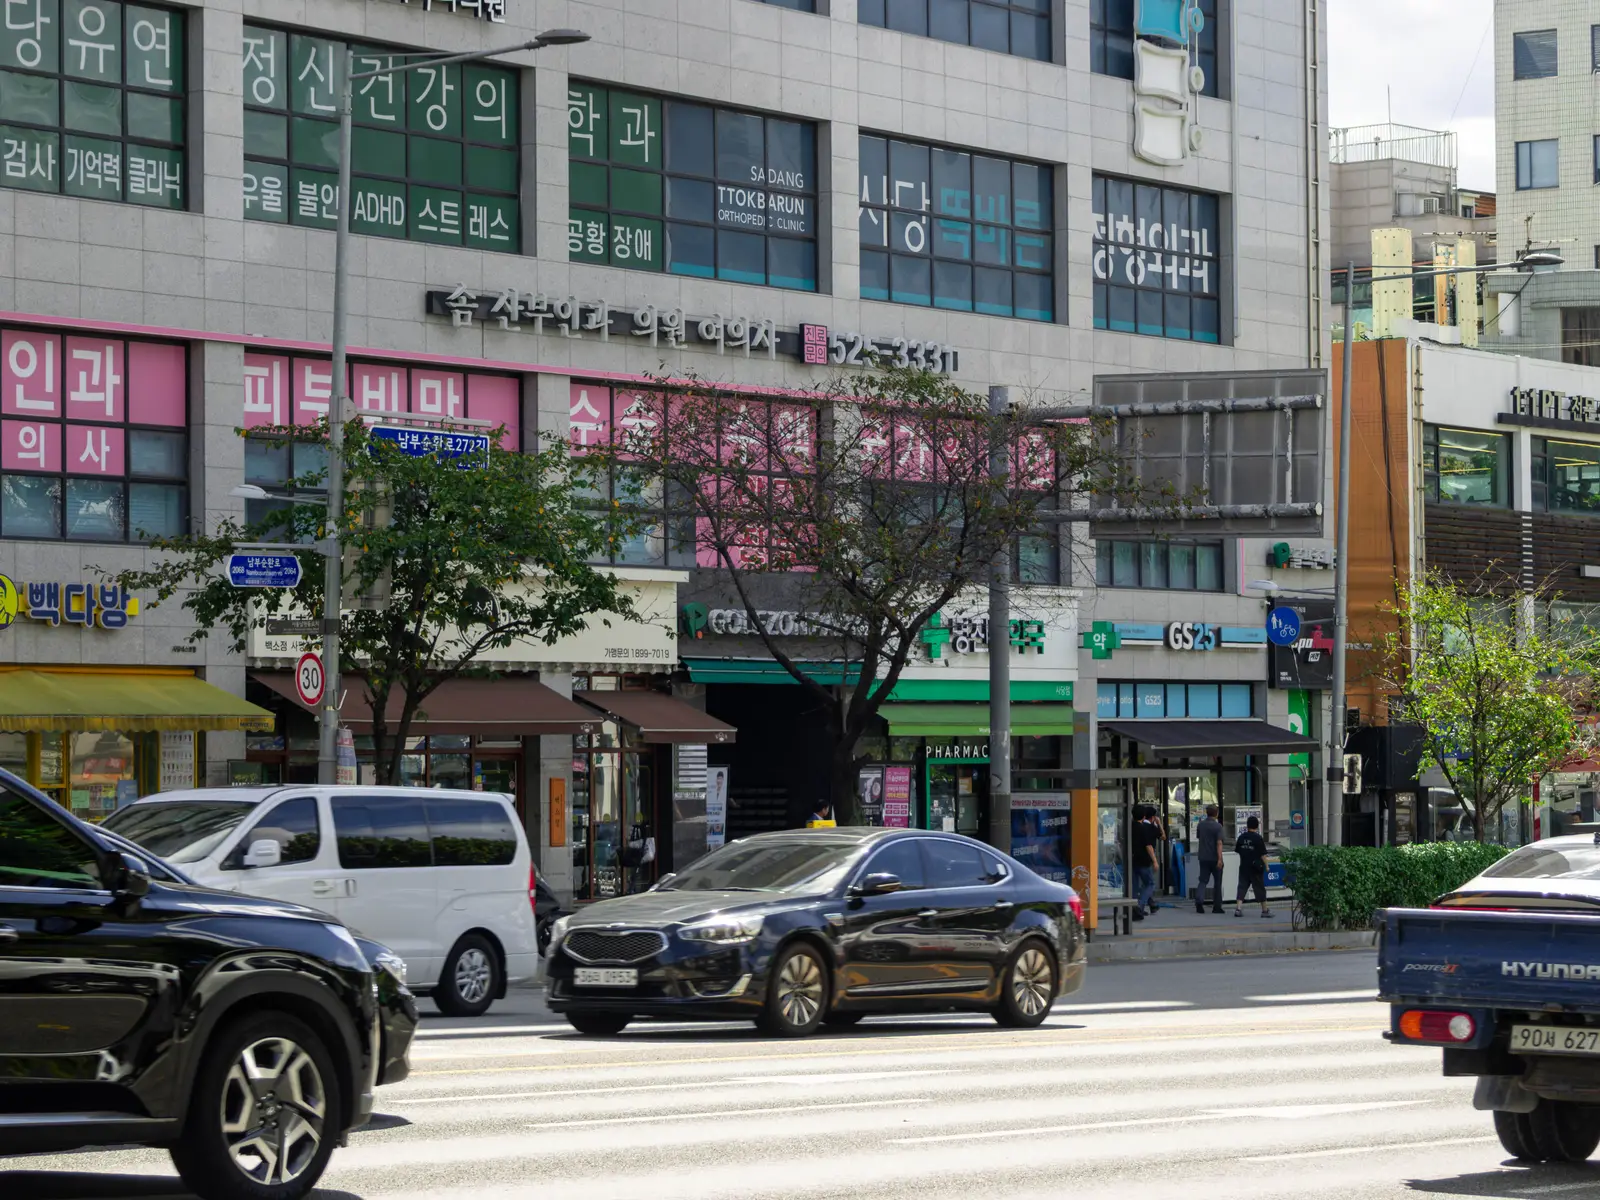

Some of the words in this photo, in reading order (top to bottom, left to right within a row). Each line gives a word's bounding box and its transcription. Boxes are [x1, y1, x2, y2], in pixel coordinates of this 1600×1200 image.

[3, 138, 56, 182] 검사
[67, 148, 120, 192] 기억력
[129, 156, 181, 200] 클리닉
[750, 165, 804, 188] SADANG
[243, 173, 282, 213] 우울
[353, 191, 405, 226] ADHD
[717, 186, 804, 216] TTOKBARUN
[717, 209, 774, 229] ORTHOPEDIC
[776, 217, 805, 233] CLINIC
[859, 175, 931, 253] 사당
[940, 187, 1045, 270] 똑바른
[1091, 212, 1213, 294] 정형외과
[568, 218, 606, 255] 공황
[613, 225, 652, 261] 장애
[490, 288, 613, 341] 산부인과
[631, 304, 688, 349] 의원
[698, 313, 780, 361] 여의사
[804, 323, 827, 344] 진료
[804, 344, 827, 364] 문의
[8, 339, 121, 416] 인과
[18, 425, 110, 472] 의사
[1093, 633, 1107, 650] 약
[1168, 621, 1216, 651] GS25
[631, 648, 670, 659] 1899-7019
[302, 667, 319, 690] 30
[1144, 695, 1162, 706] GS25
[1520, 1028, 1555, 1048] 90서
